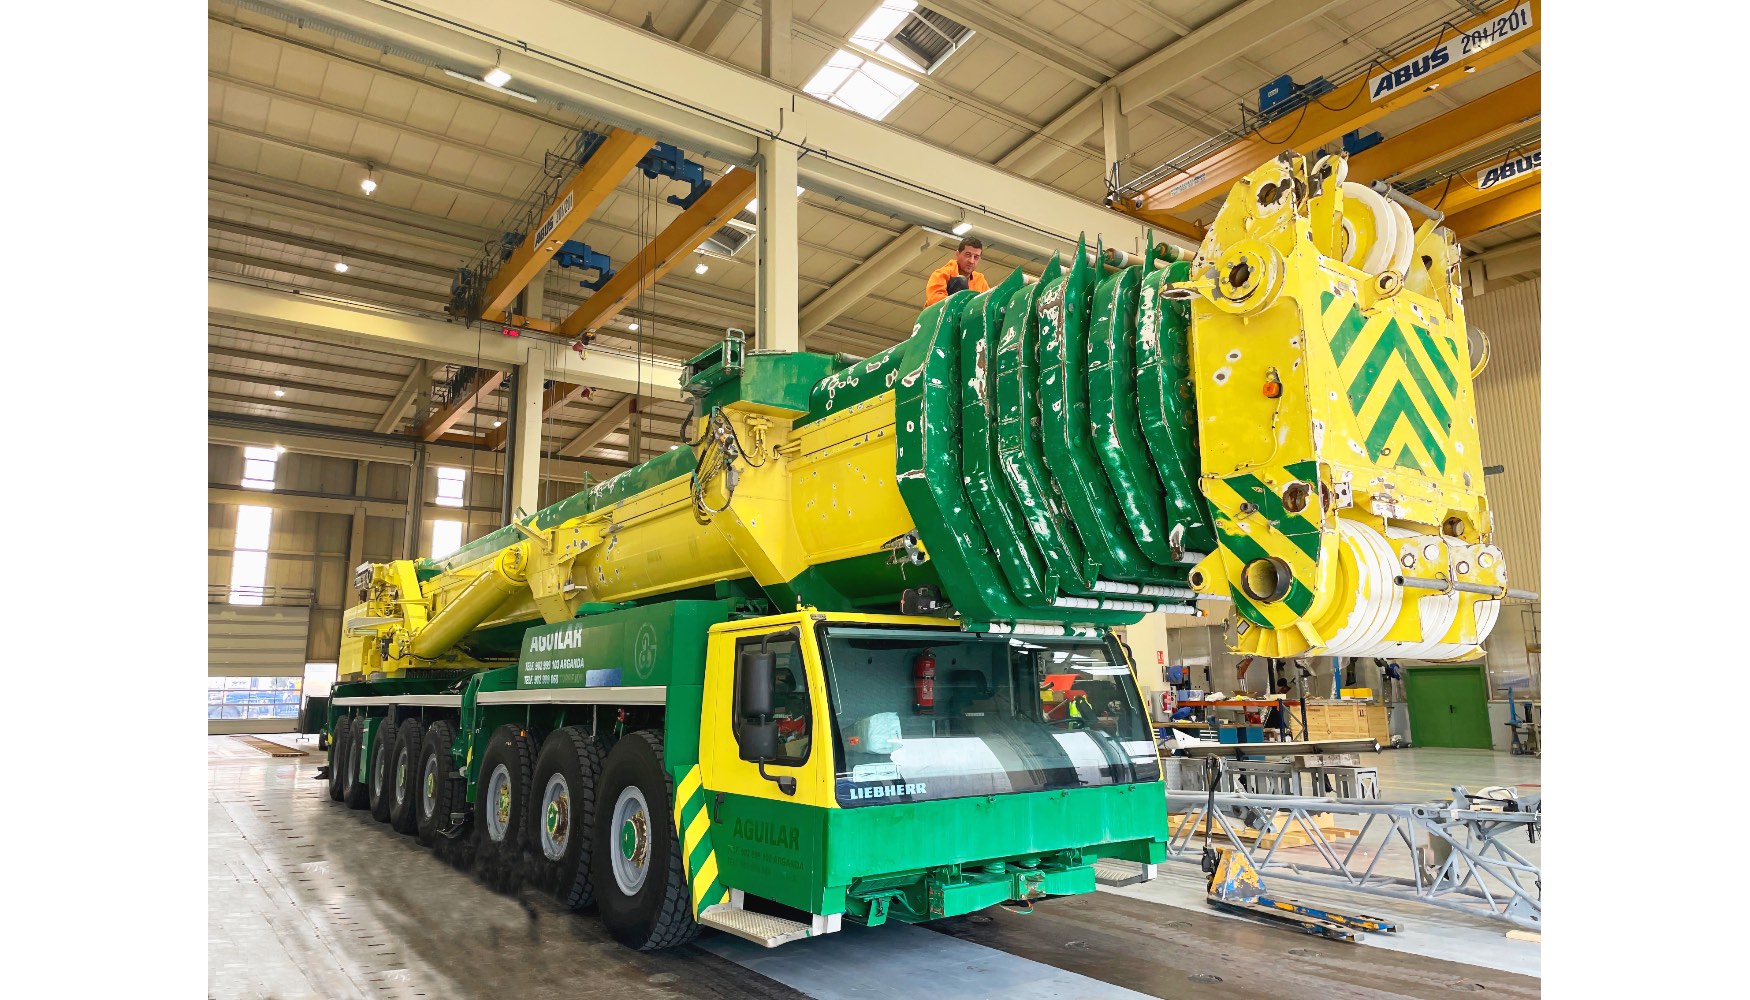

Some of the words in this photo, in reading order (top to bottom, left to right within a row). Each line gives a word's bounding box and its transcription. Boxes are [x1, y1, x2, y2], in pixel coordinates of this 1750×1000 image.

[1373, 46, 1450, 98] ABUS
[529, 625, 583, 653] AGUILAR
[849, 782, 928, 800] LIEBHERR
[732, 816, 800, 851] AGUILAR
